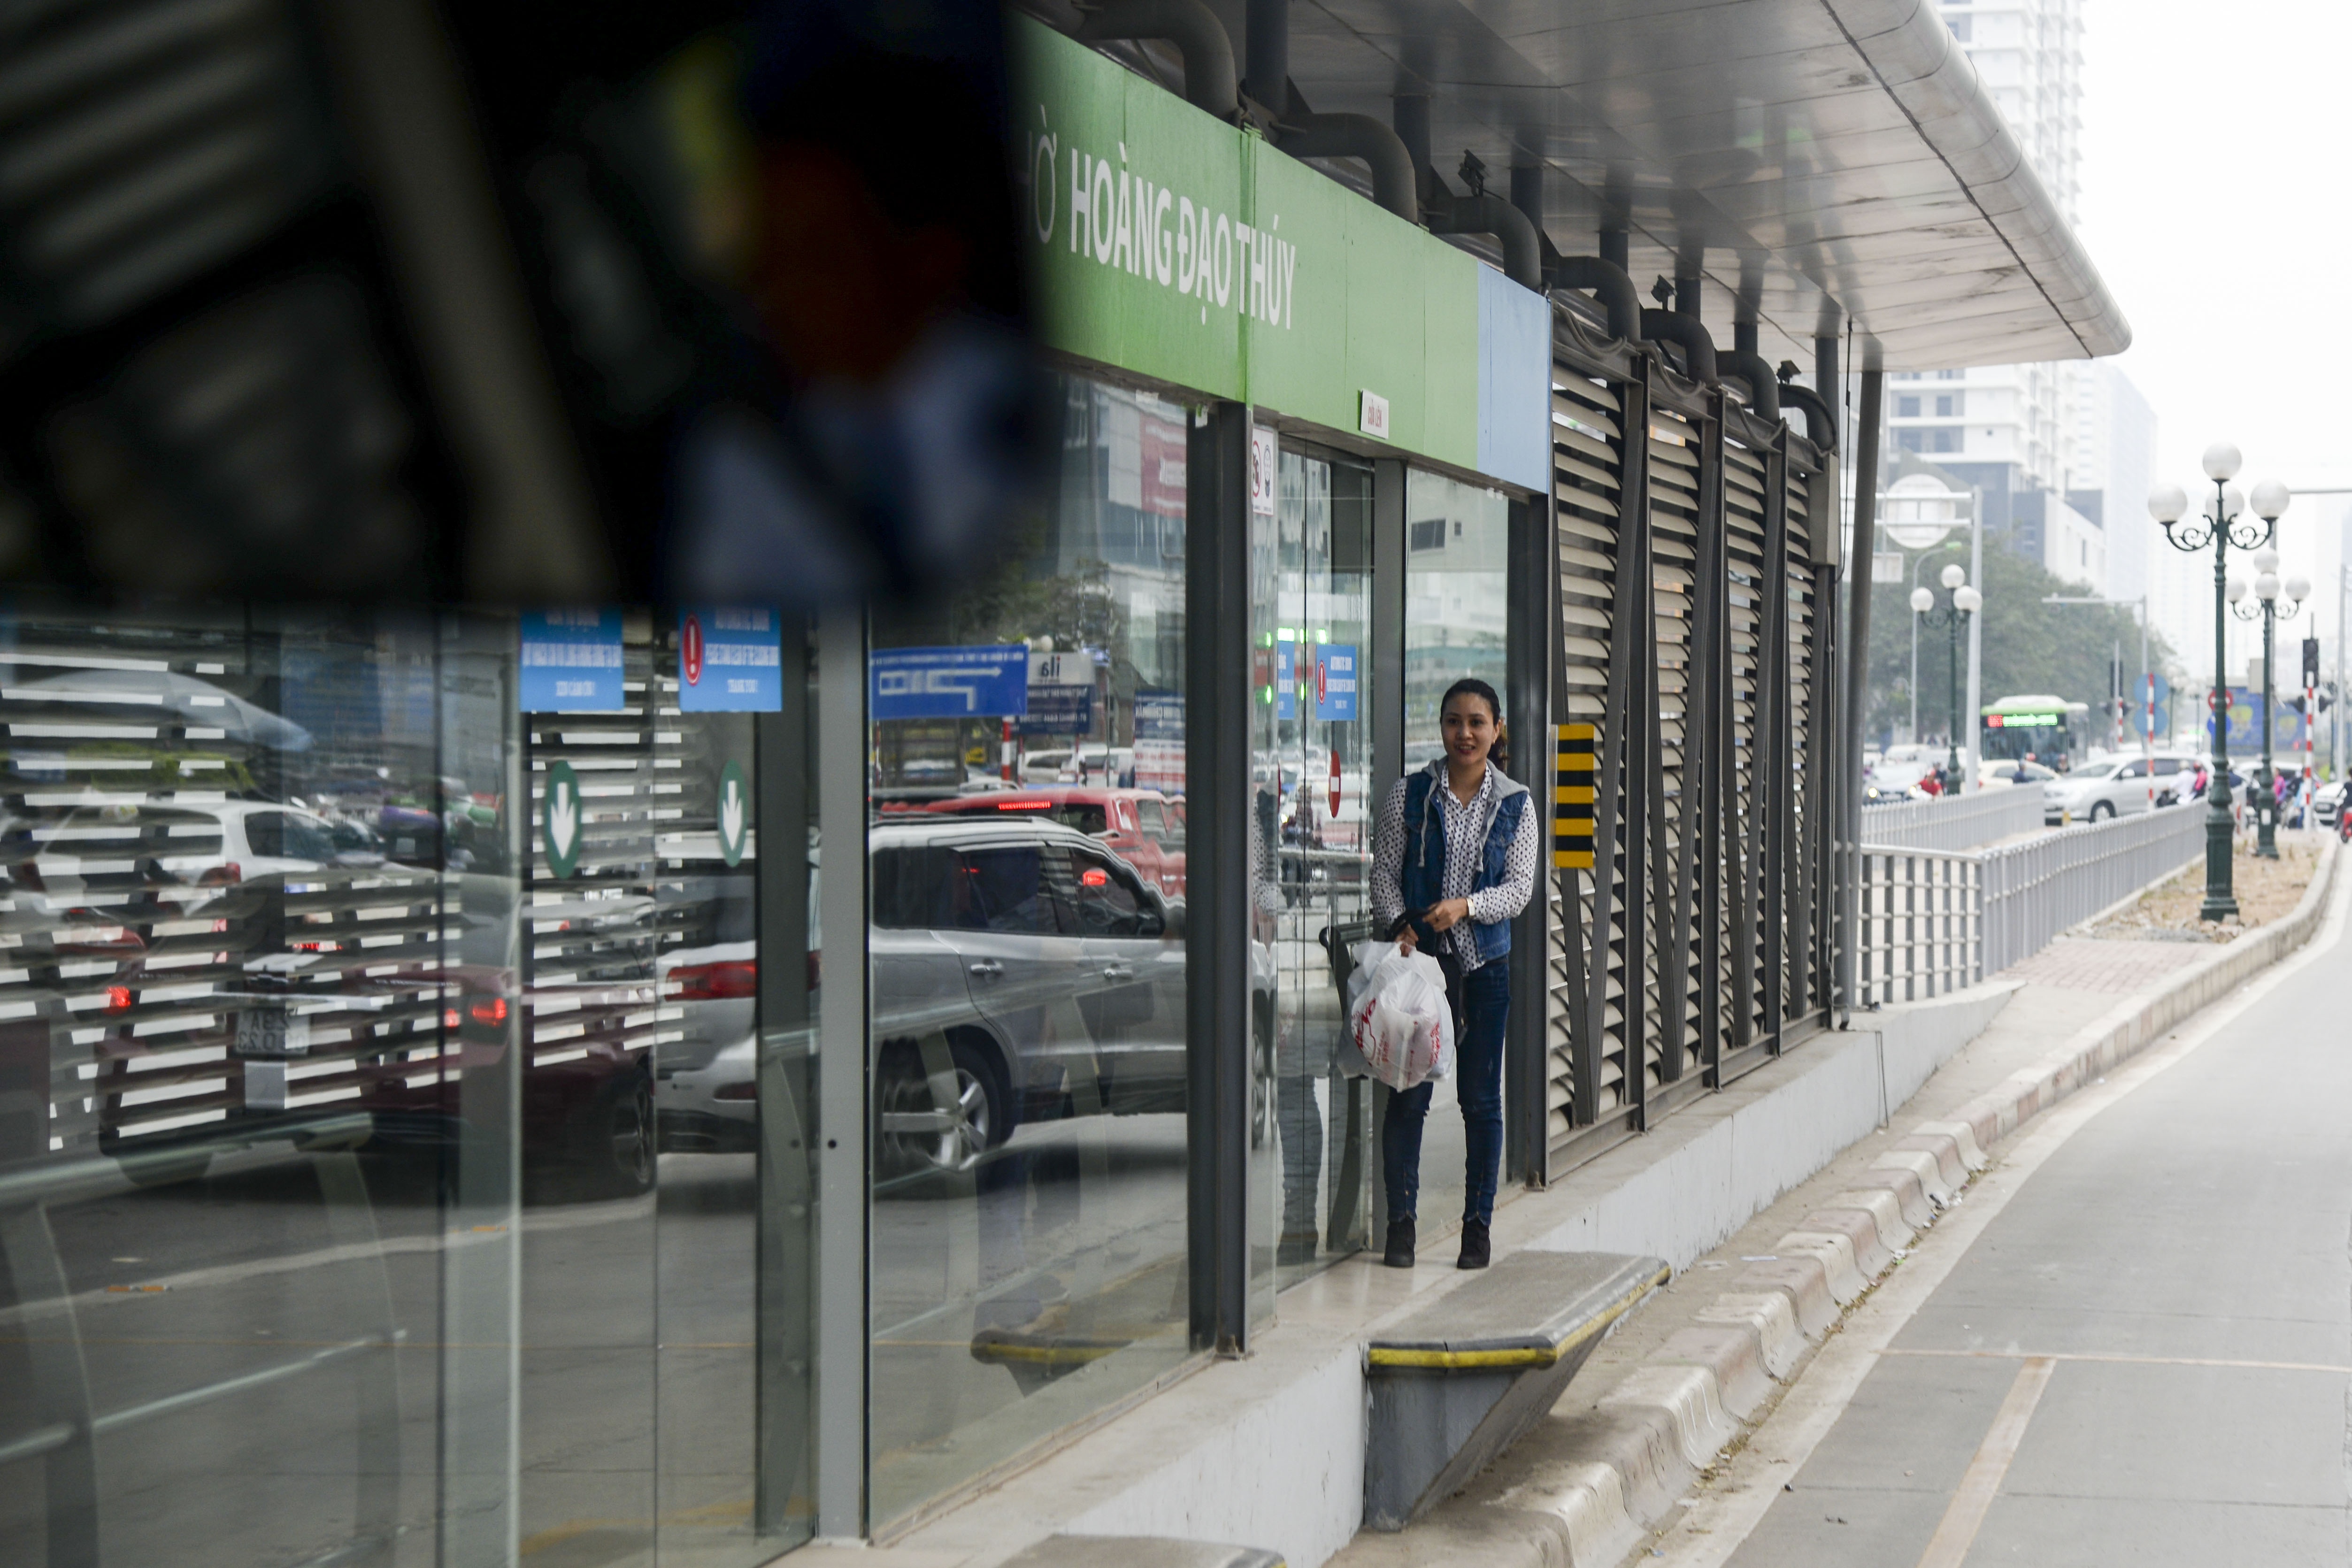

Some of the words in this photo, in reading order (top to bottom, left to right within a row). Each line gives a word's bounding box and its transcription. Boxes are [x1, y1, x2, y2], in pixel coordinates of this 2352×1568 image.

[1070, 141, 1173, 287] HOÀNG
[1177, 196, 1231, 326] ĐẠO
[1236, 214, 1296, 330] THÚY
